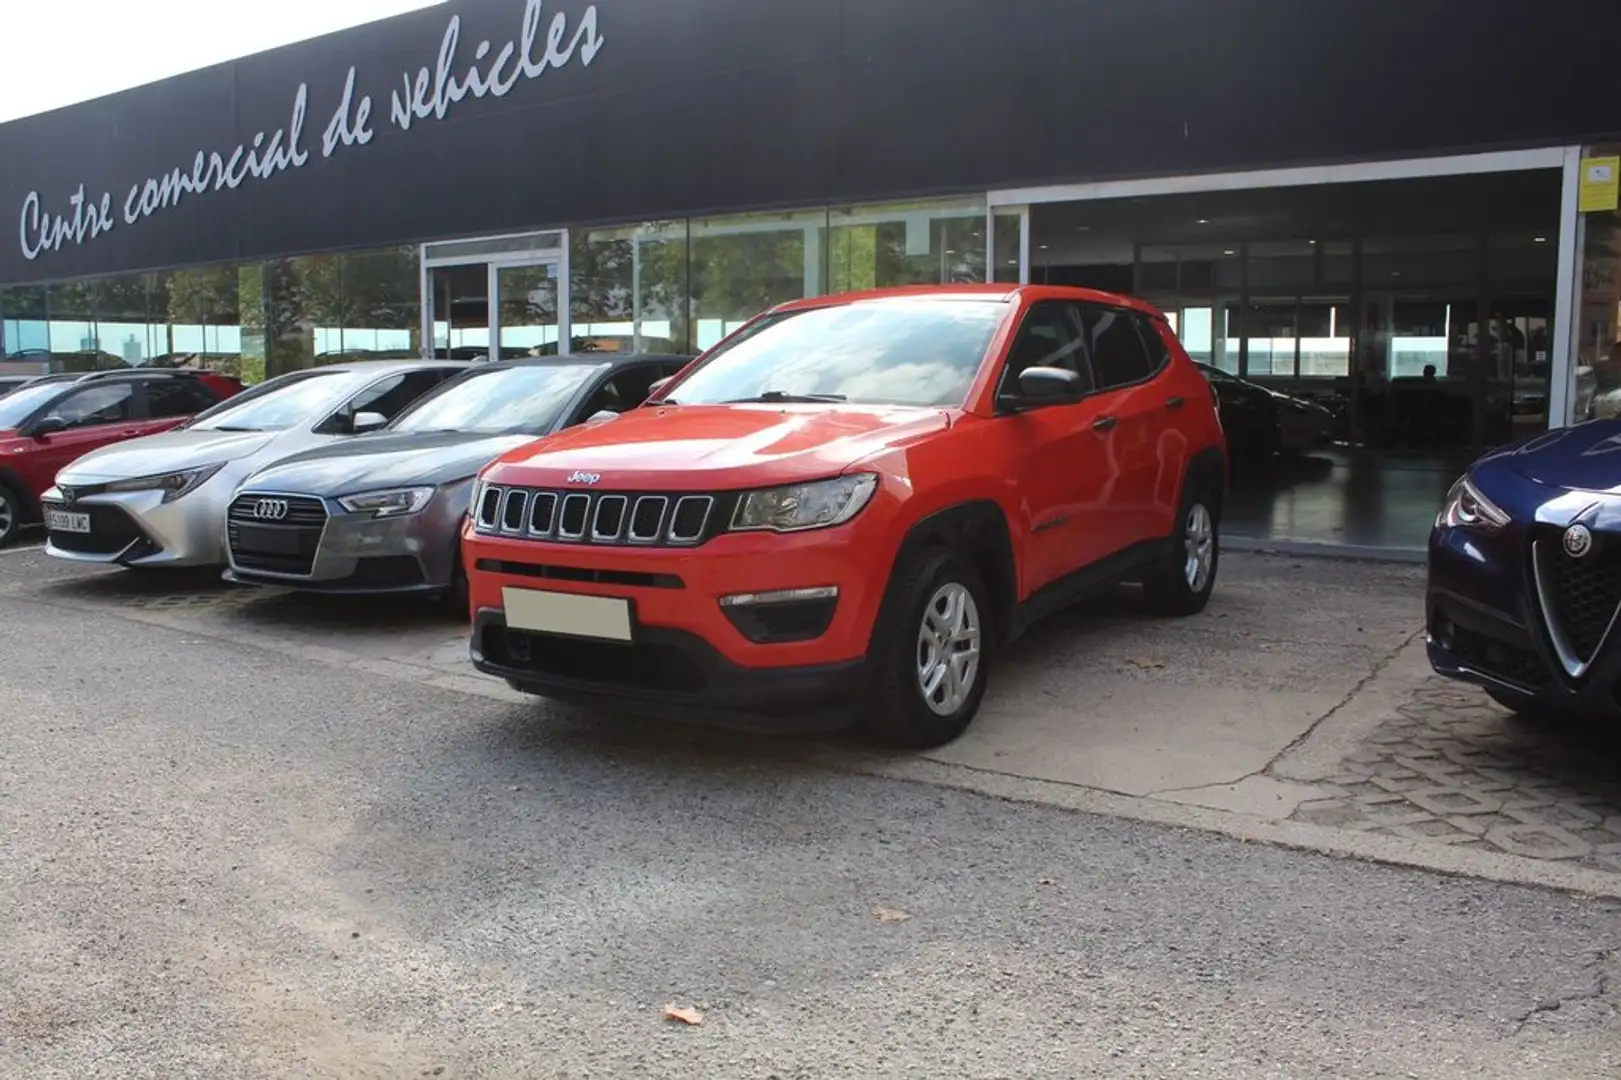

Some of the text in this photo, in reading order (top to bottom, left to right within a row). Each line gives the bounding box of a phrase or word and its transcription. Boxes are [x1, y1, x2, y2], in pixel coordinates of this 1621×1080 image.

[20, 0, 605, 260] Centre comercial de vehicles
[567, 470, 601, 485] Jeep
